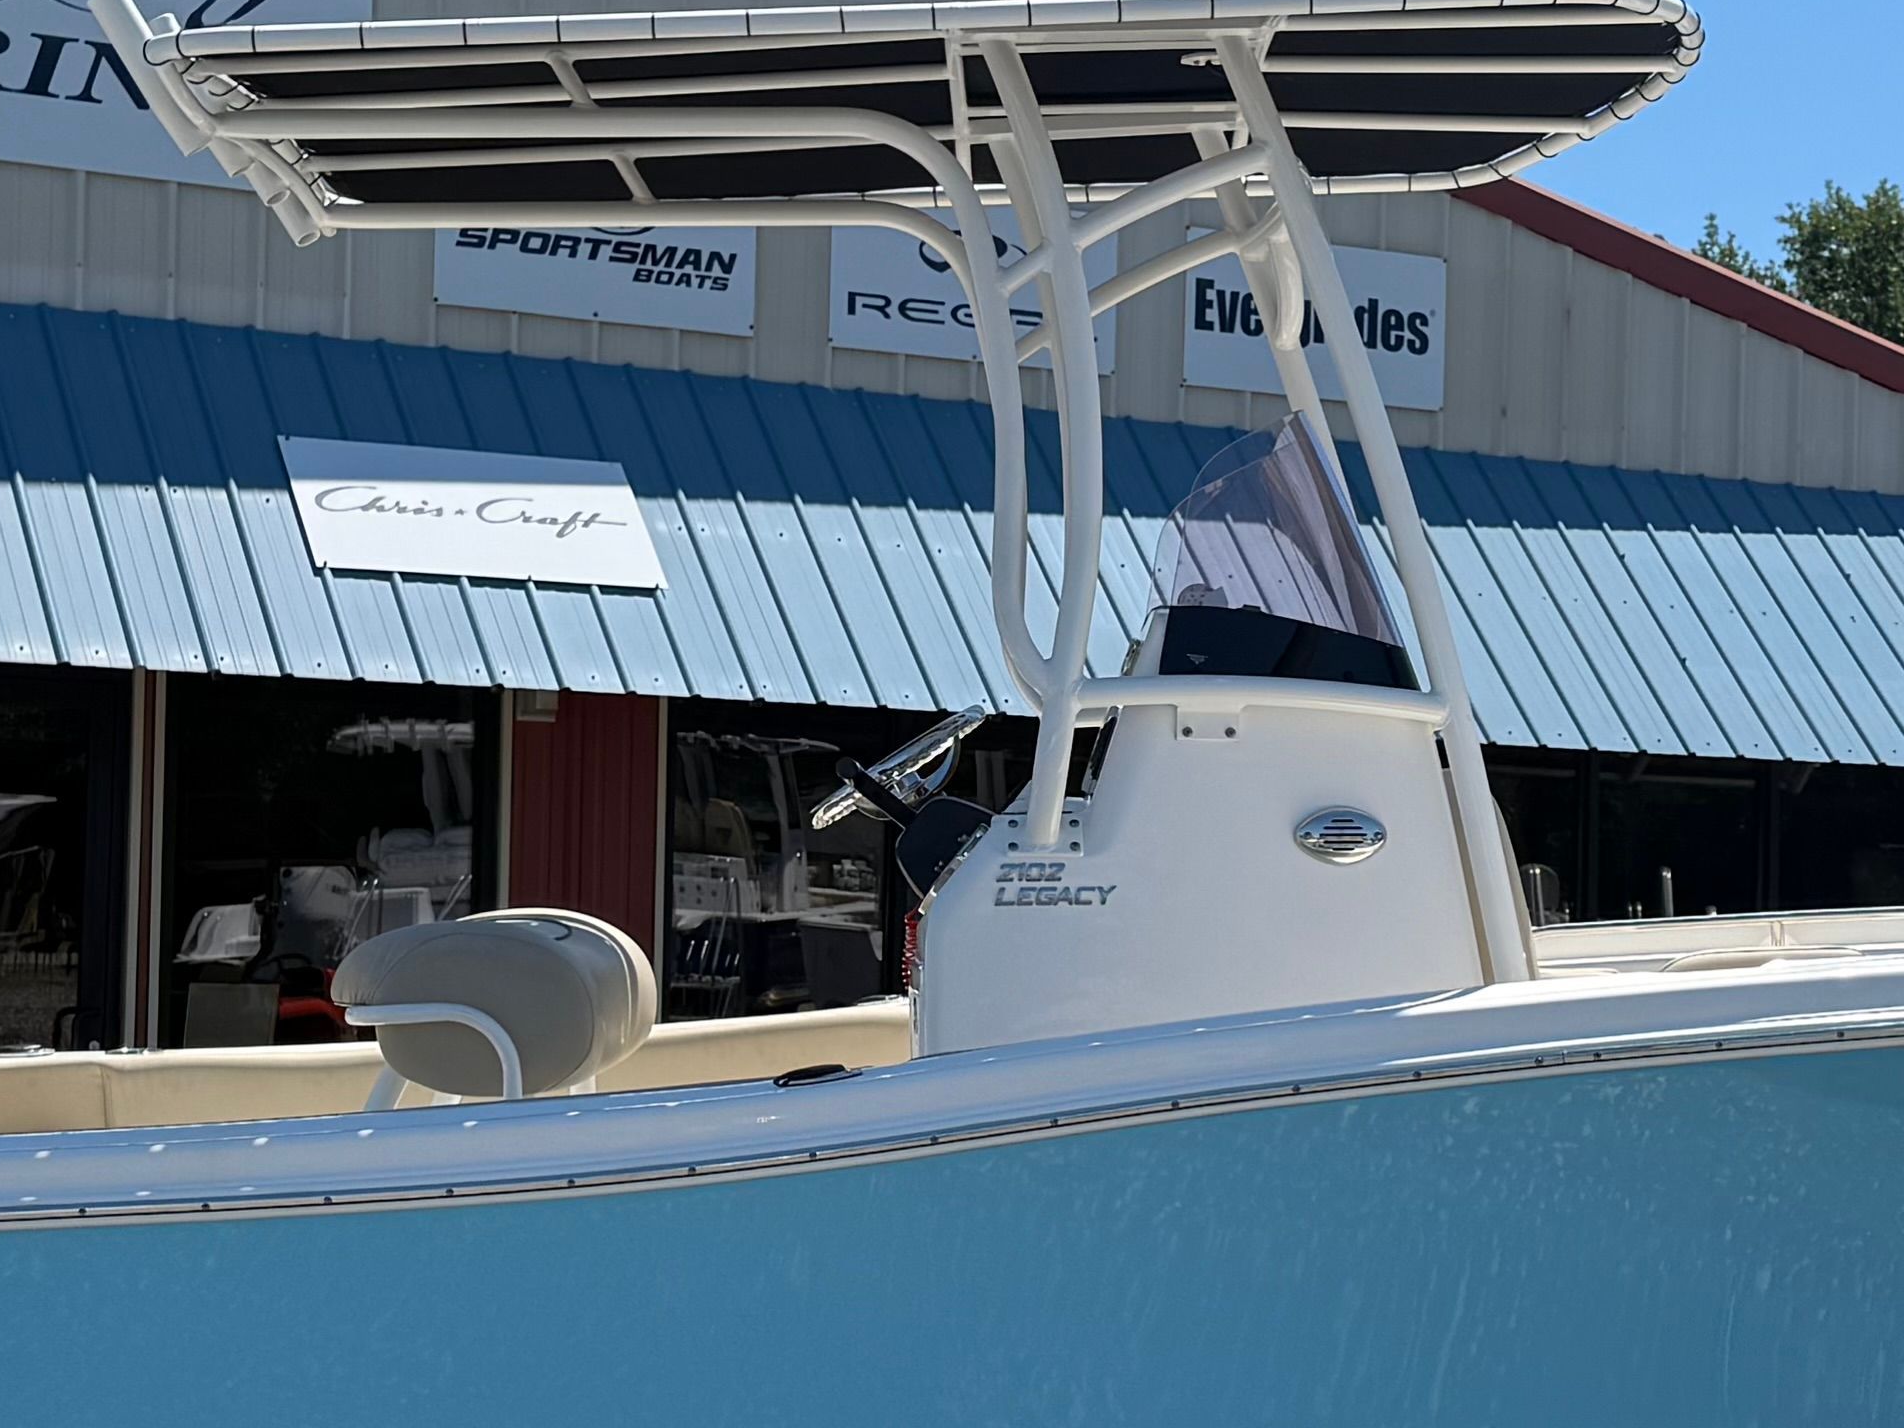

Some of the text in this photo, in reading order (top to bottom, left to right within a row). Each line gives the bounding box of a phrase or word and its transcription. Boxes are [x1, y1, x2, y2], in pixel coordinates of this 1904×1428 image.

[455, 227, 738, 275] SPORTSMAN
[632, 267, 730, 292] BOATS
[314, 485, 628, 539] Chris Craft
[994, 884, 1117, 907] LEGACY
